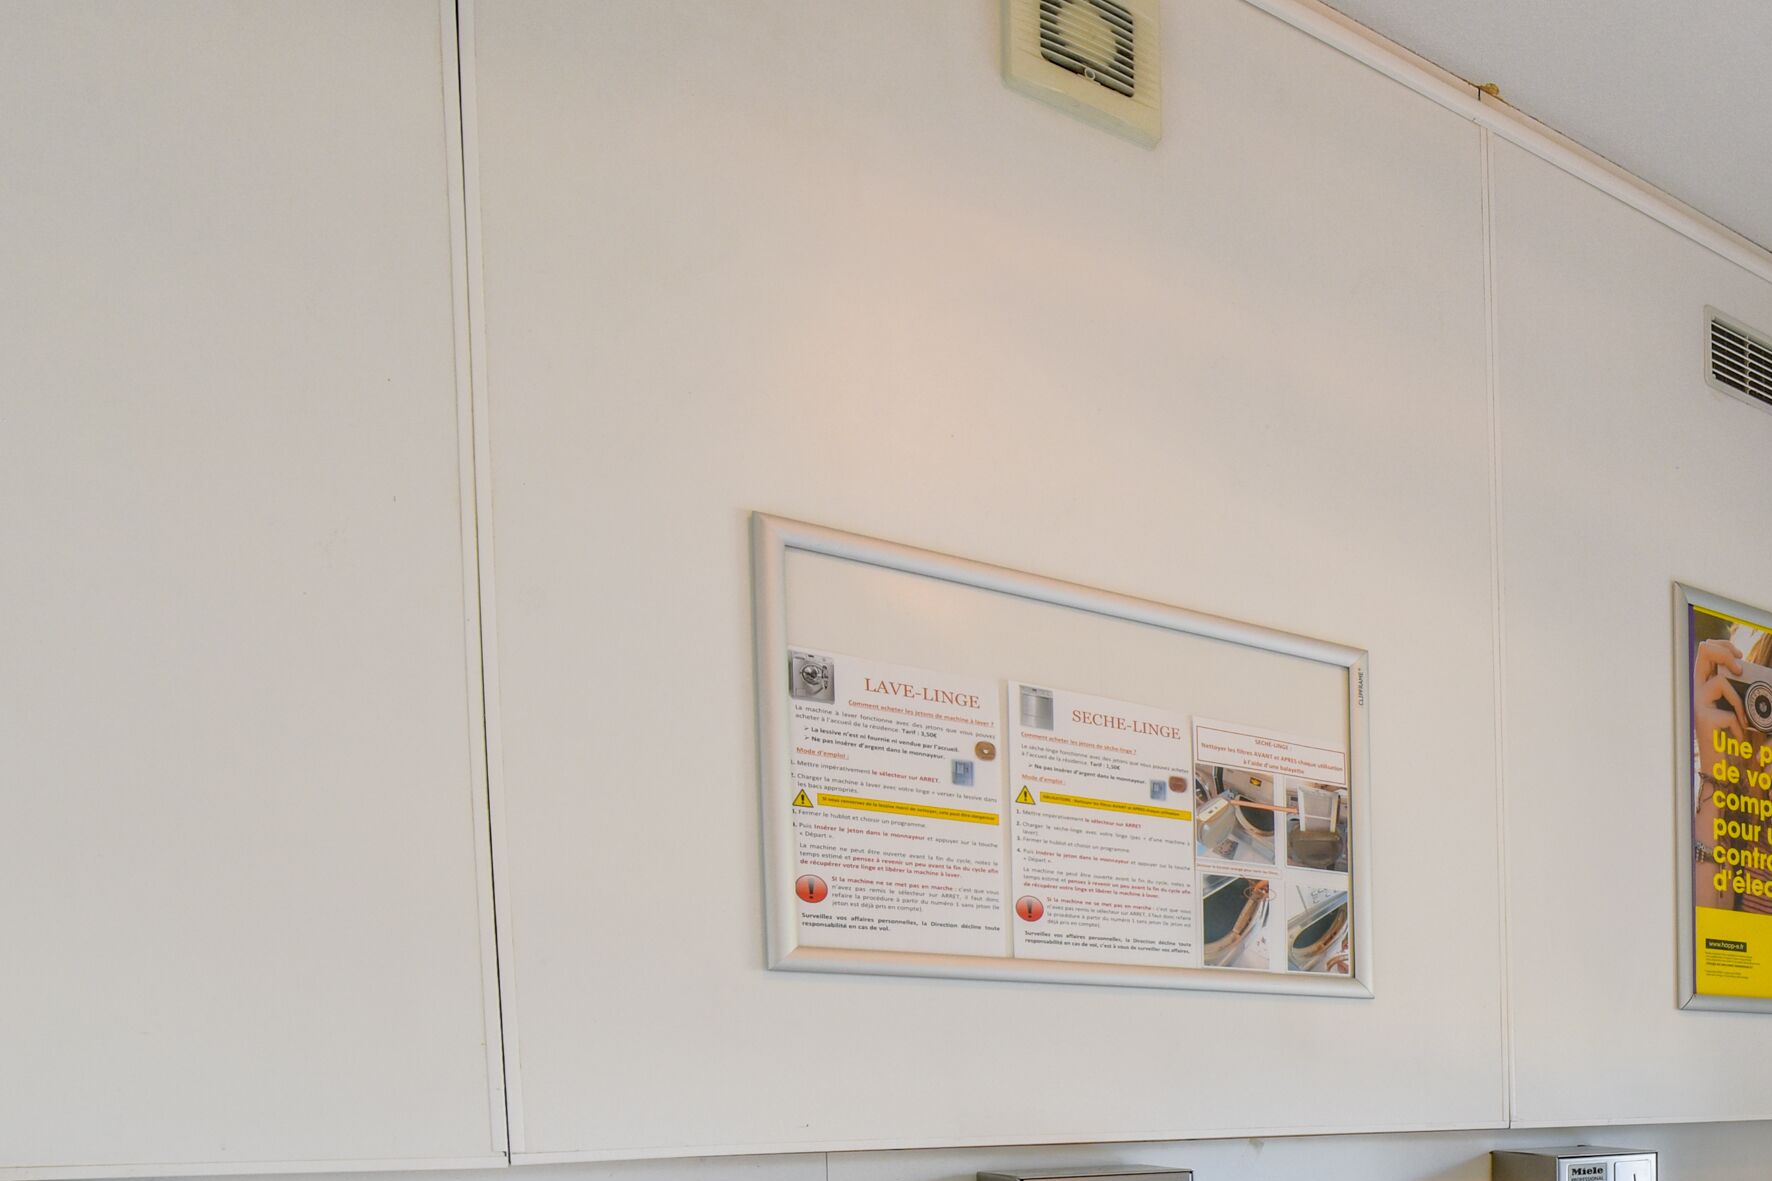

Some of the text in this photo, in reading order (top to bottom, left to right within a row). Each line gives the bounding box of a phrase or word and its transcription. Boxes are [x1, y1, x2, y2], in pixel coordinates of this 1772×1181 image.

[865, 677, 979, 709] LAVE-LINGE
[1071, 710, 1181, 739] SECHE-LINGE
[1712, 729, 1753, 759] Une
[1712, 759, 1740, 784] de
[1713, 817, 1761, 842] pour
[1571, 1167, 1604, 1176] Miele
